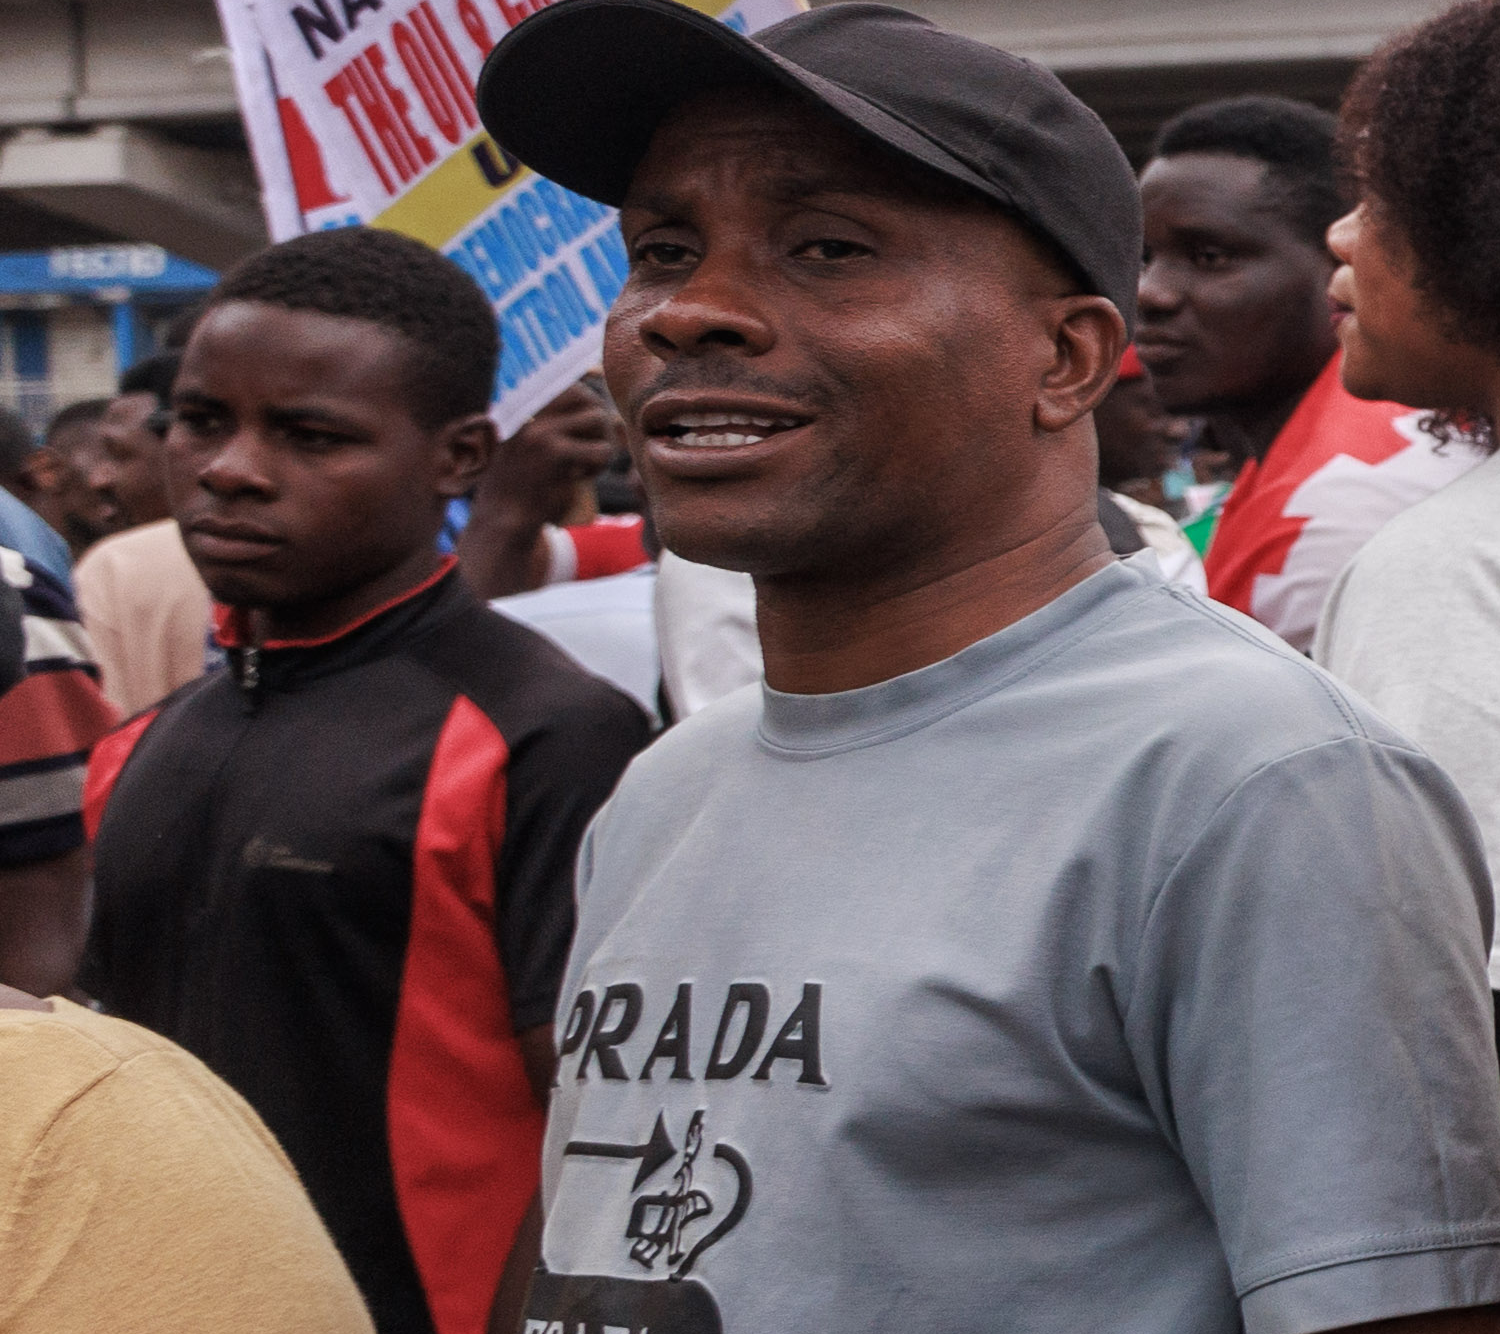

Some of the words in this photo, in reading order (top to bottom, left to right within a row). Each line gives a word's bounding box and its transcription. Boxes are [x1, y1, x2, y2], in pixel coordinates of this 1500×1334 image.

[323, 41, 438, 198] THE
[390, 0, 479, 146] OIL
[552, 982, 830, 1087] PRADA
